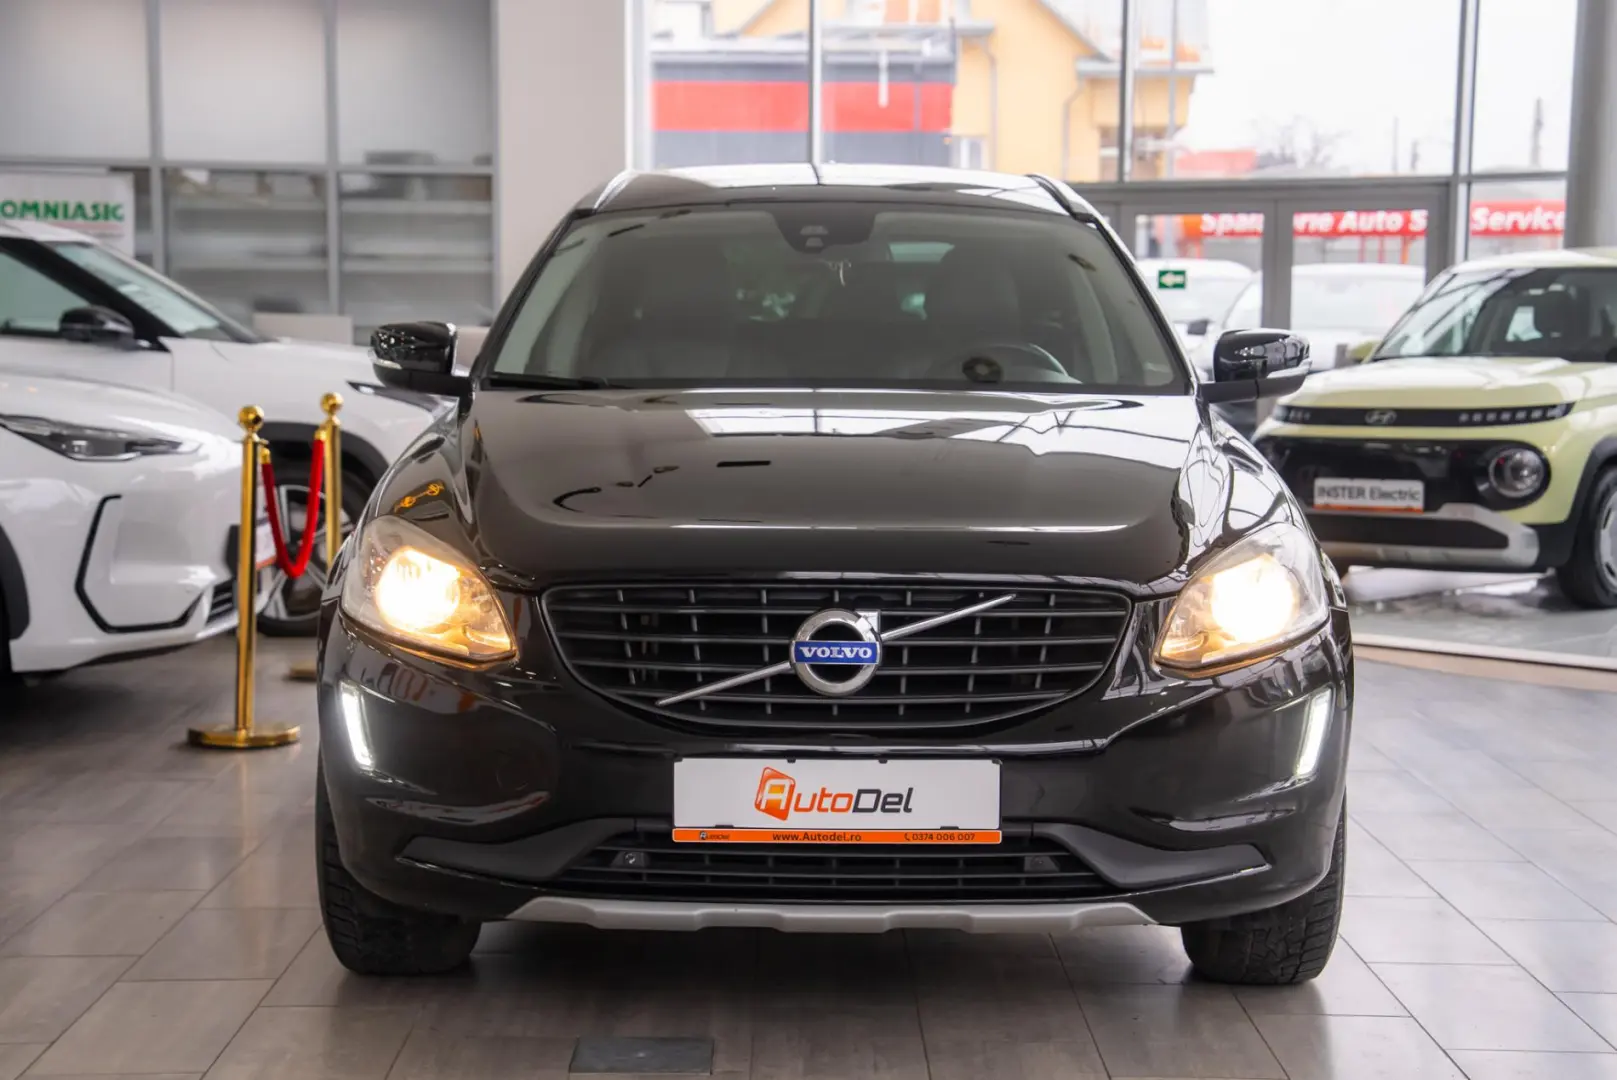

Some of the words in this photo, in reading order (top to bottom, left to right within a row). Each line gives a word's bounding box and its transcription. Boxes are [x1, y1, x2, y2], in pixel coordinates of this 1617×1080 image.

[1338, 210, 1404, 232] Auto
[799, 646, 873, 659] VOLVO
[757, 774, 914, 814] AutoDel
[772, 832, 862, 842] www.Autodel.ro
[911, 832, 934, 841] 0374
[936, 832, 956, 841] 006
[957, 832, 976, 841] 007
